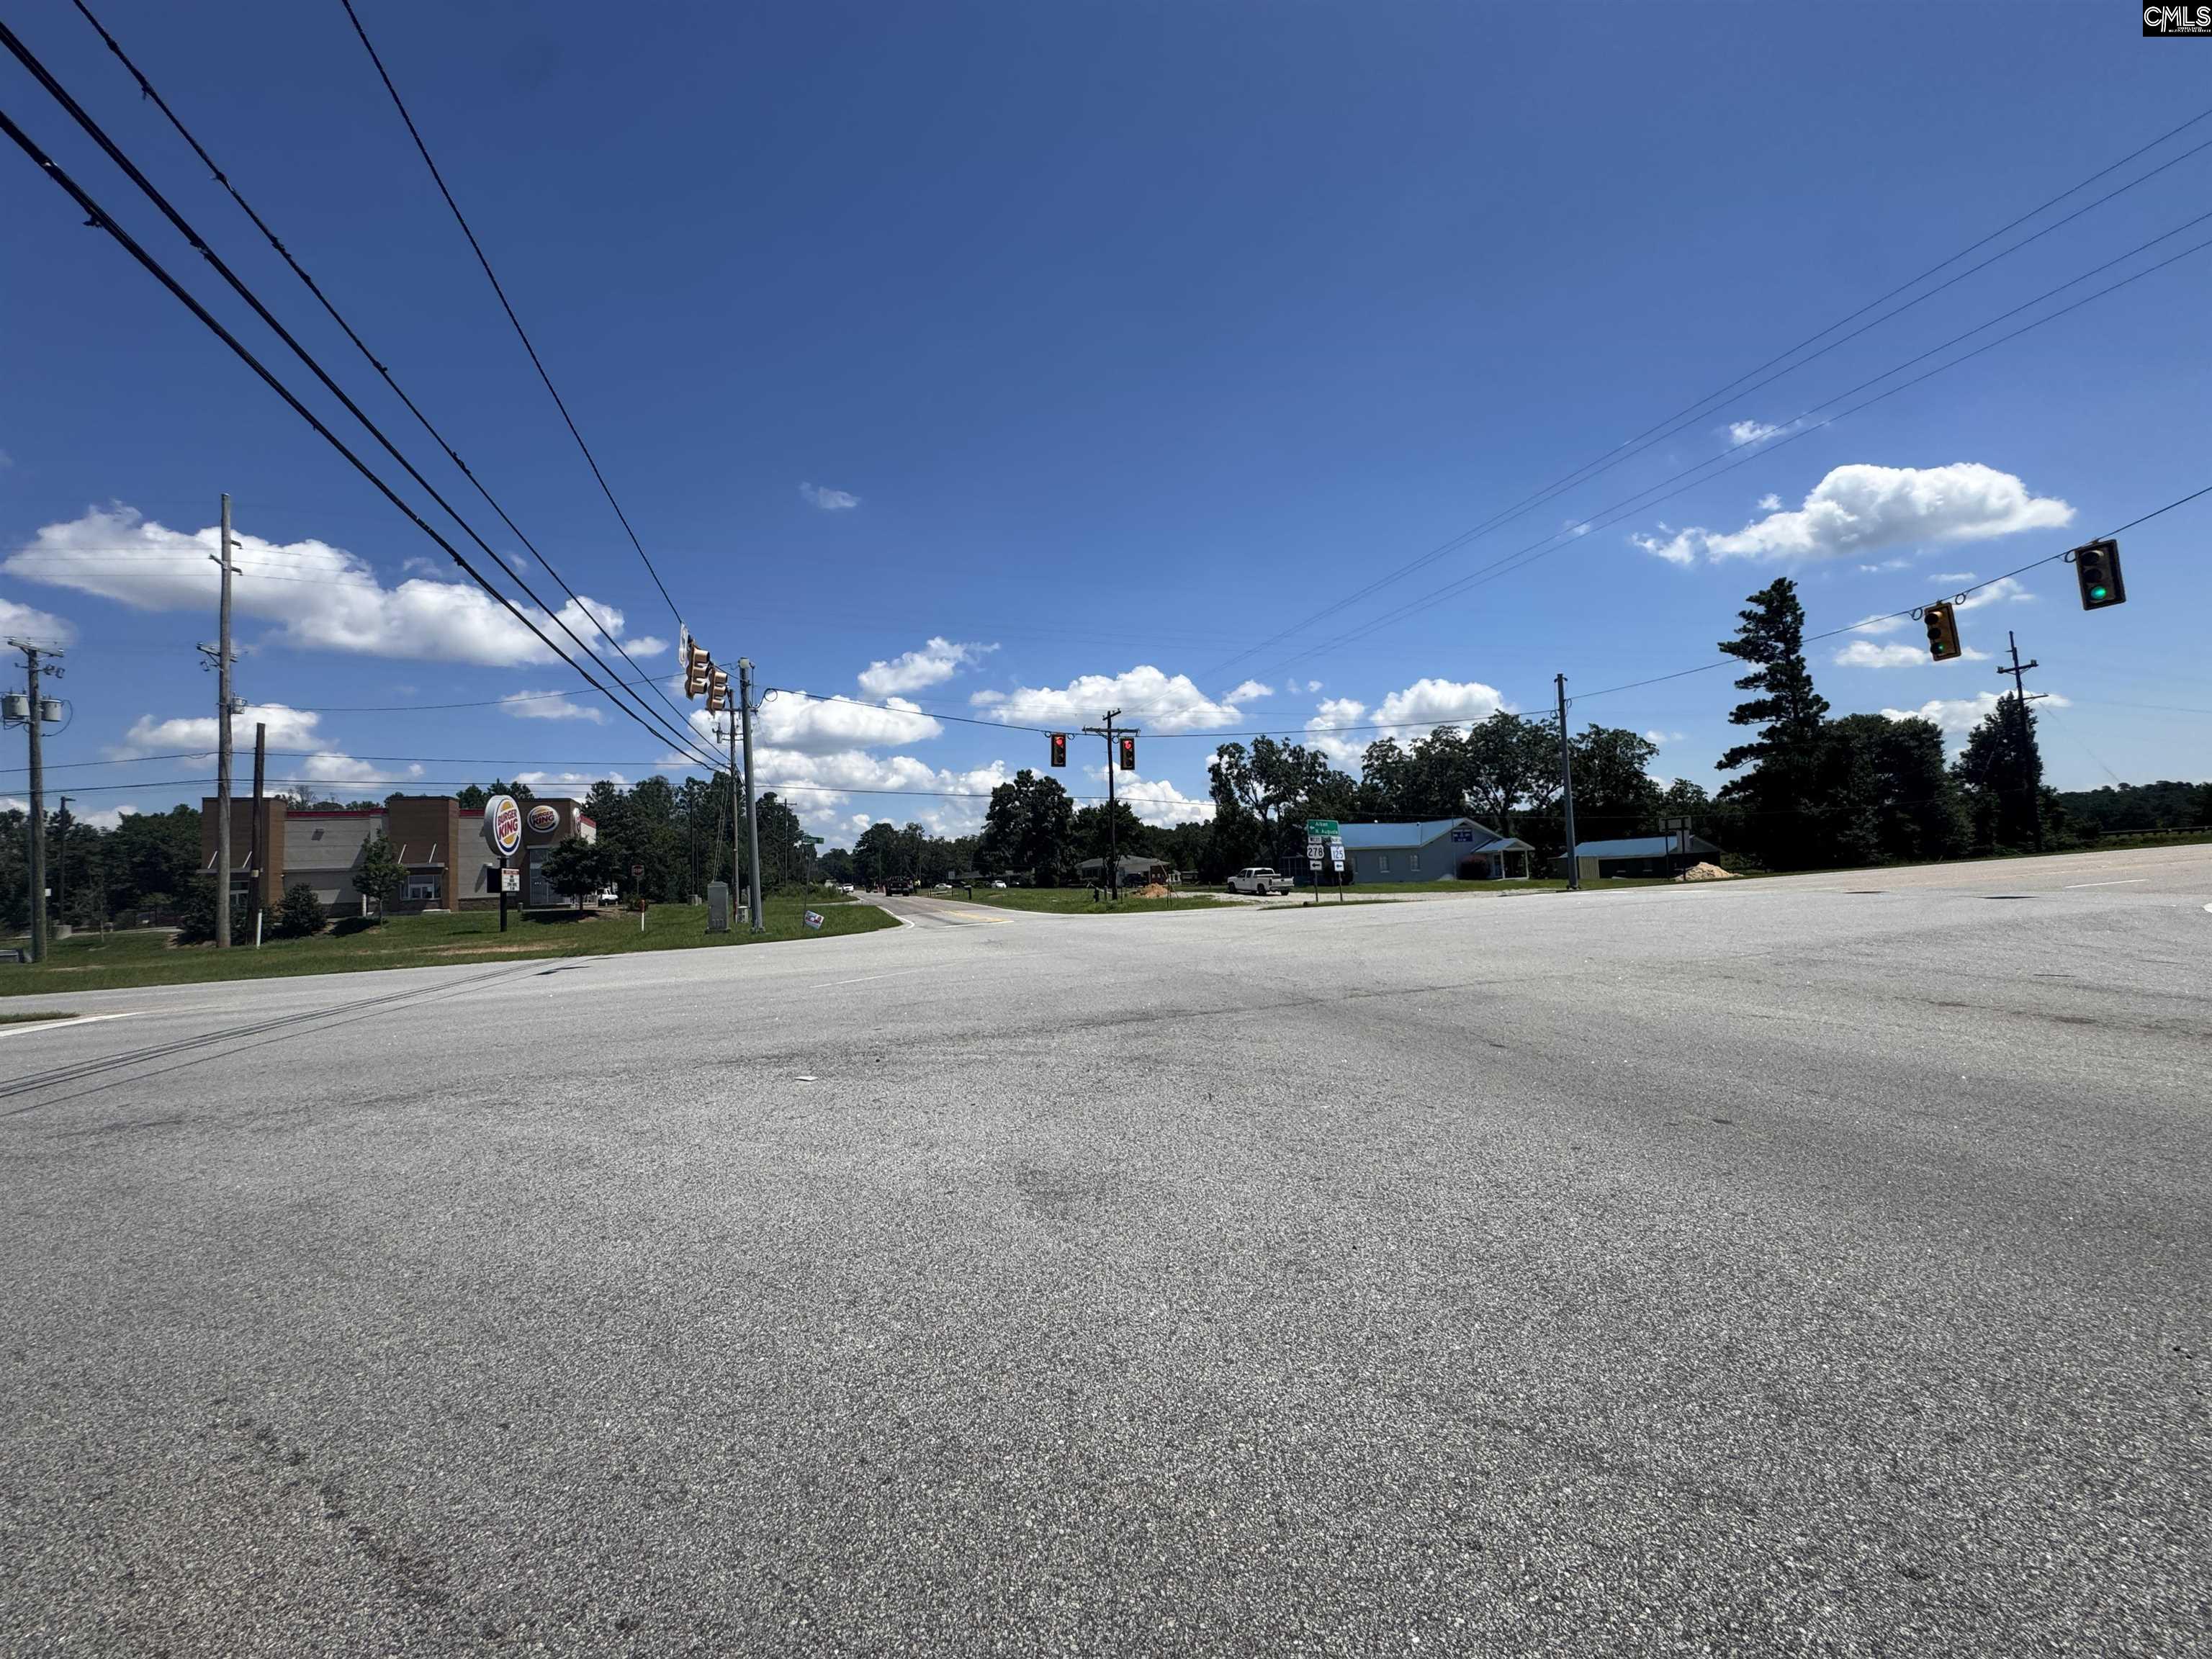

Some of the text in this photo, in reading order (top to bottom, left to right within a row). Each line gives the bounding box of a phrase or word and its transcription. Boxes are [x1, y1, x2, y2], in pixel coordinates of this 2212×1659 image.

[498, 809, 517, 826] BURGER
[533, 811, 553, 819] BURGER
[534, 815, 554, 825] KING
[498, 819, 518, 840] KING
[1308, 848, 1323, 857] 278
[1333, 850, 1343, 859] 125
